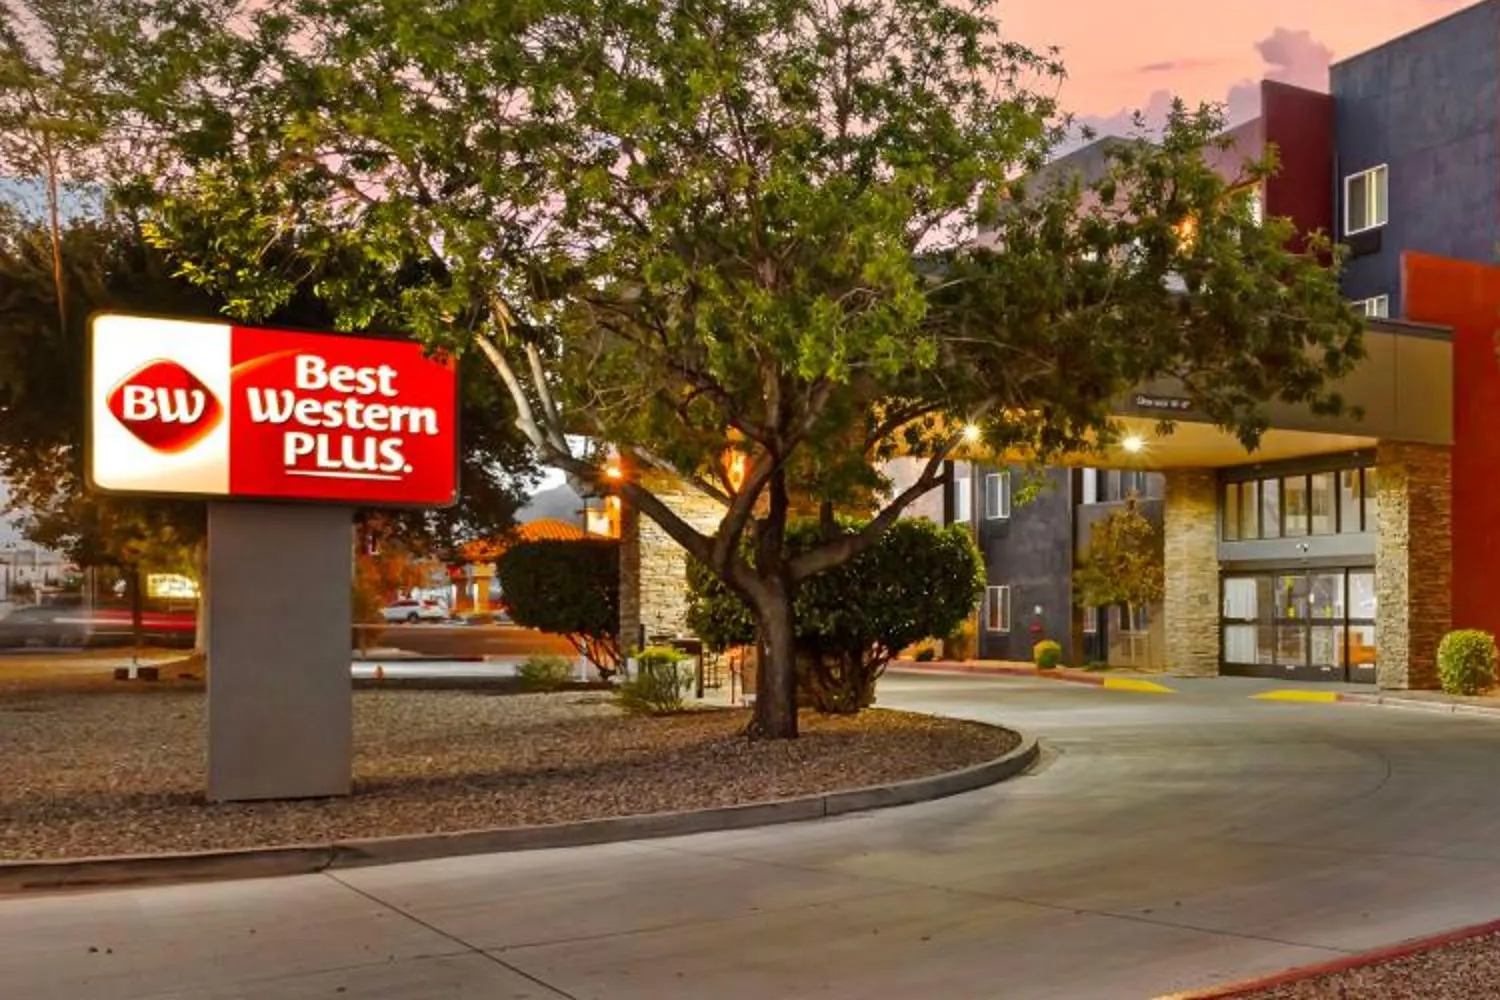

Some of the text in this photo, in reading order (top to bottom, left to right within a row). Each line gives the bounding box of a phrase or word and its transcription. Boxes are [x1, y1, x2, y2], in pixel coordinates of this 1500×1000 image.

[295, 355, 398, 396] Best
[122, 385, 205, 424] BW
[246, 387, 439, 435] Western
